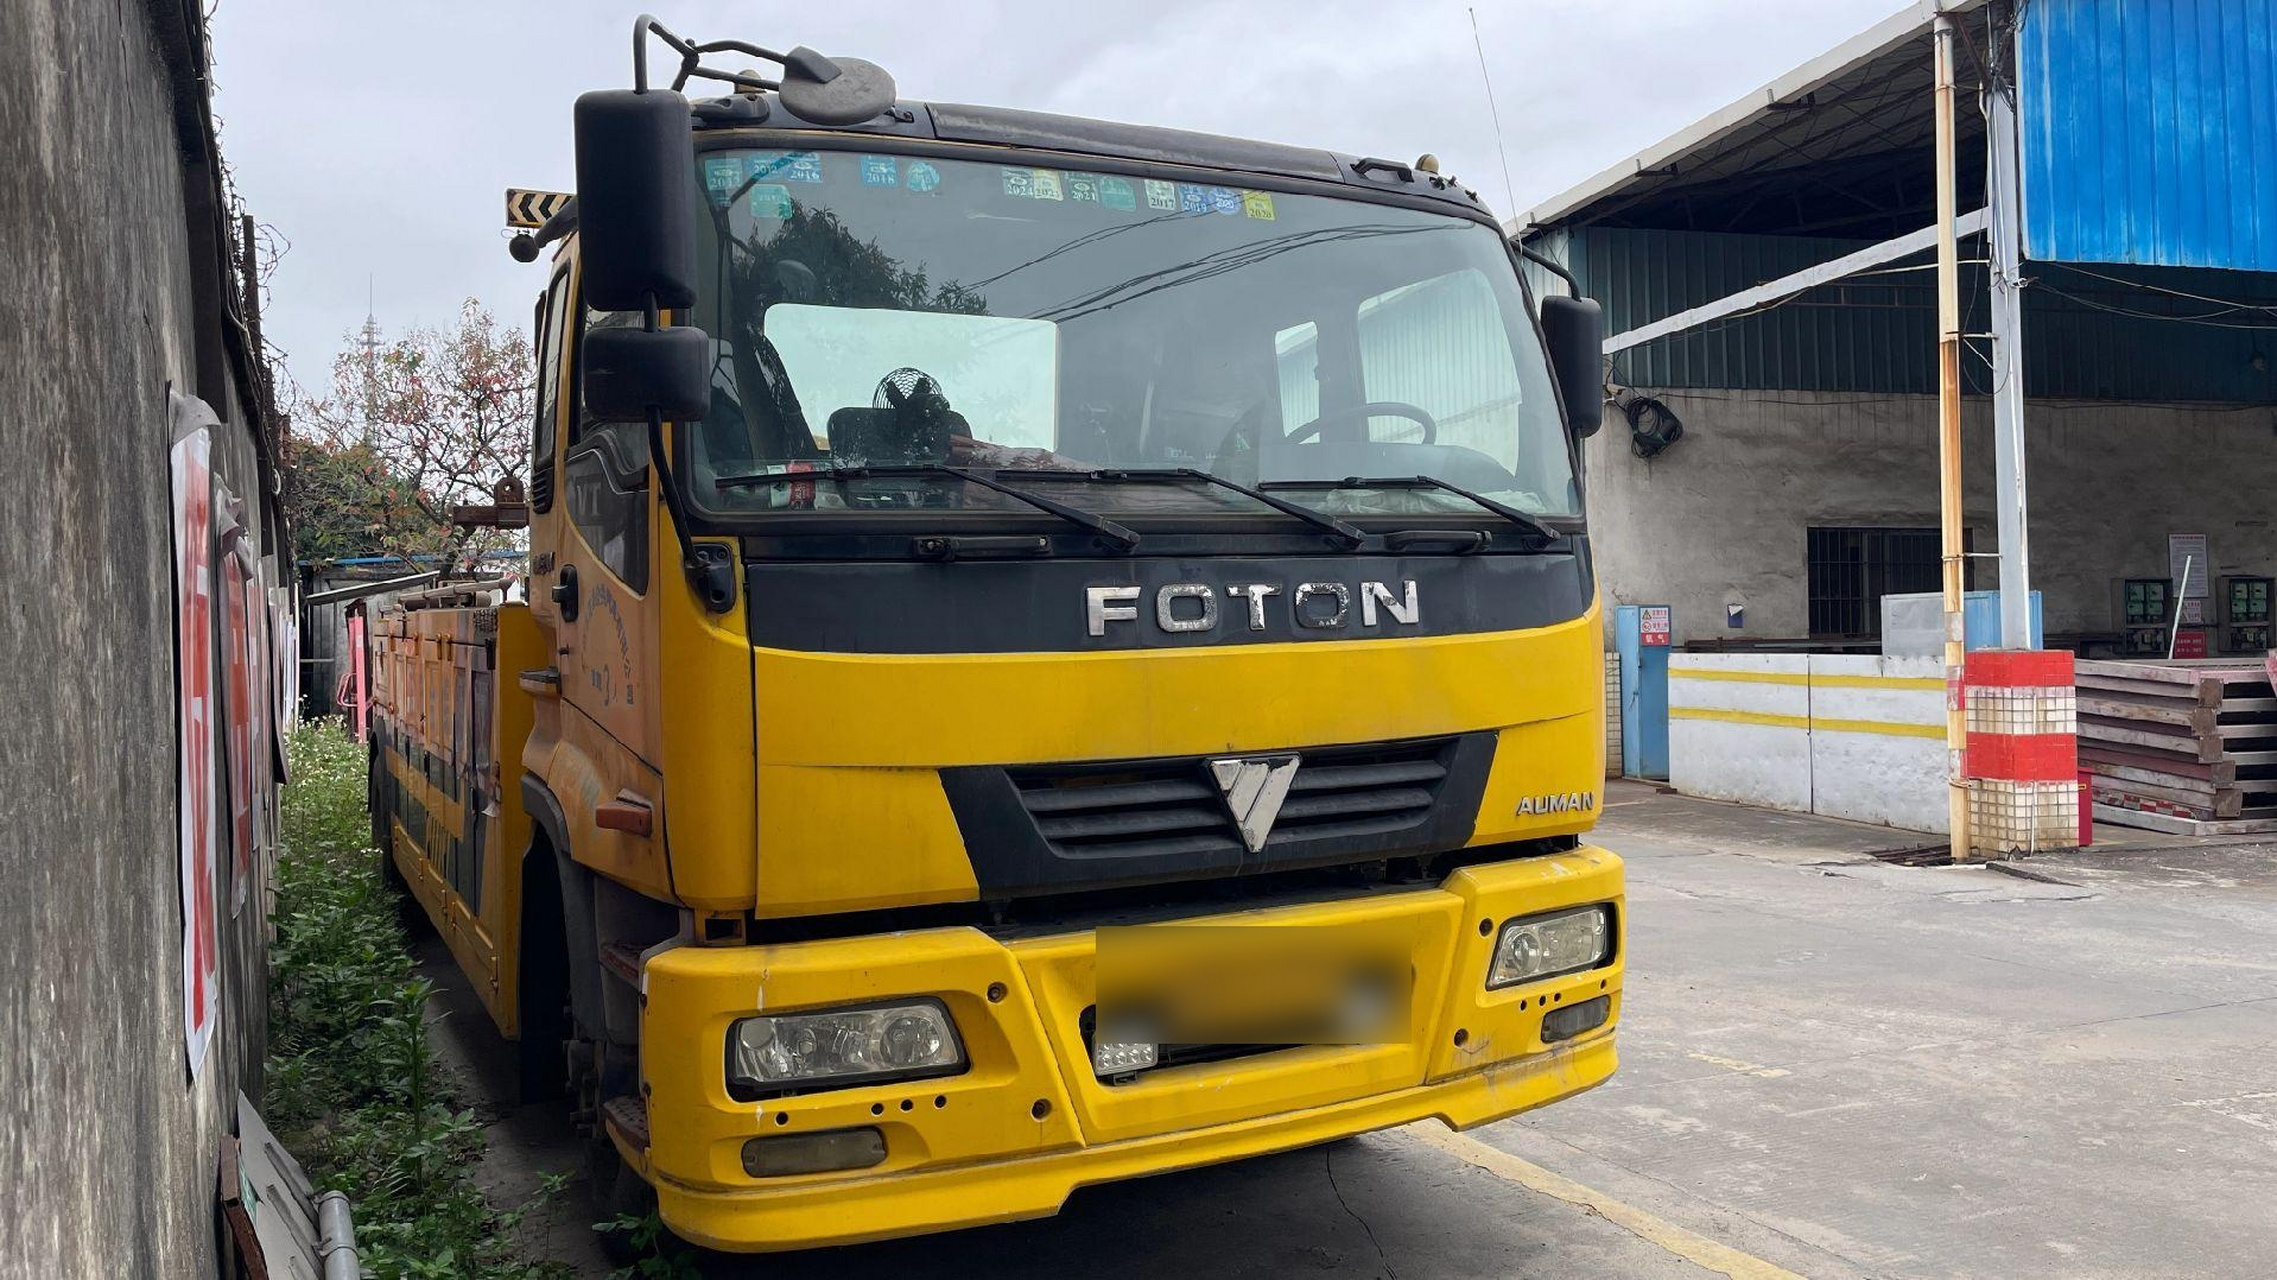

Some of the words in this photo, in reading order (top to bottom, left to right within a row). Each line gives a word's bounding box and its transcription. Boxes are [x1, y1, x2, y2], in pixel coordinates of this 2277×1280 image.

[790, 169, 820, 180] 2016
[866, 172, 895, 184] 2018
[1150, 197, 1174, 208] 2017
[1184, 201, 1207, 213] 2019
[1086, 579, 1420, 636] FOTON
[1516, 791, 1594, 816] AUMAN
